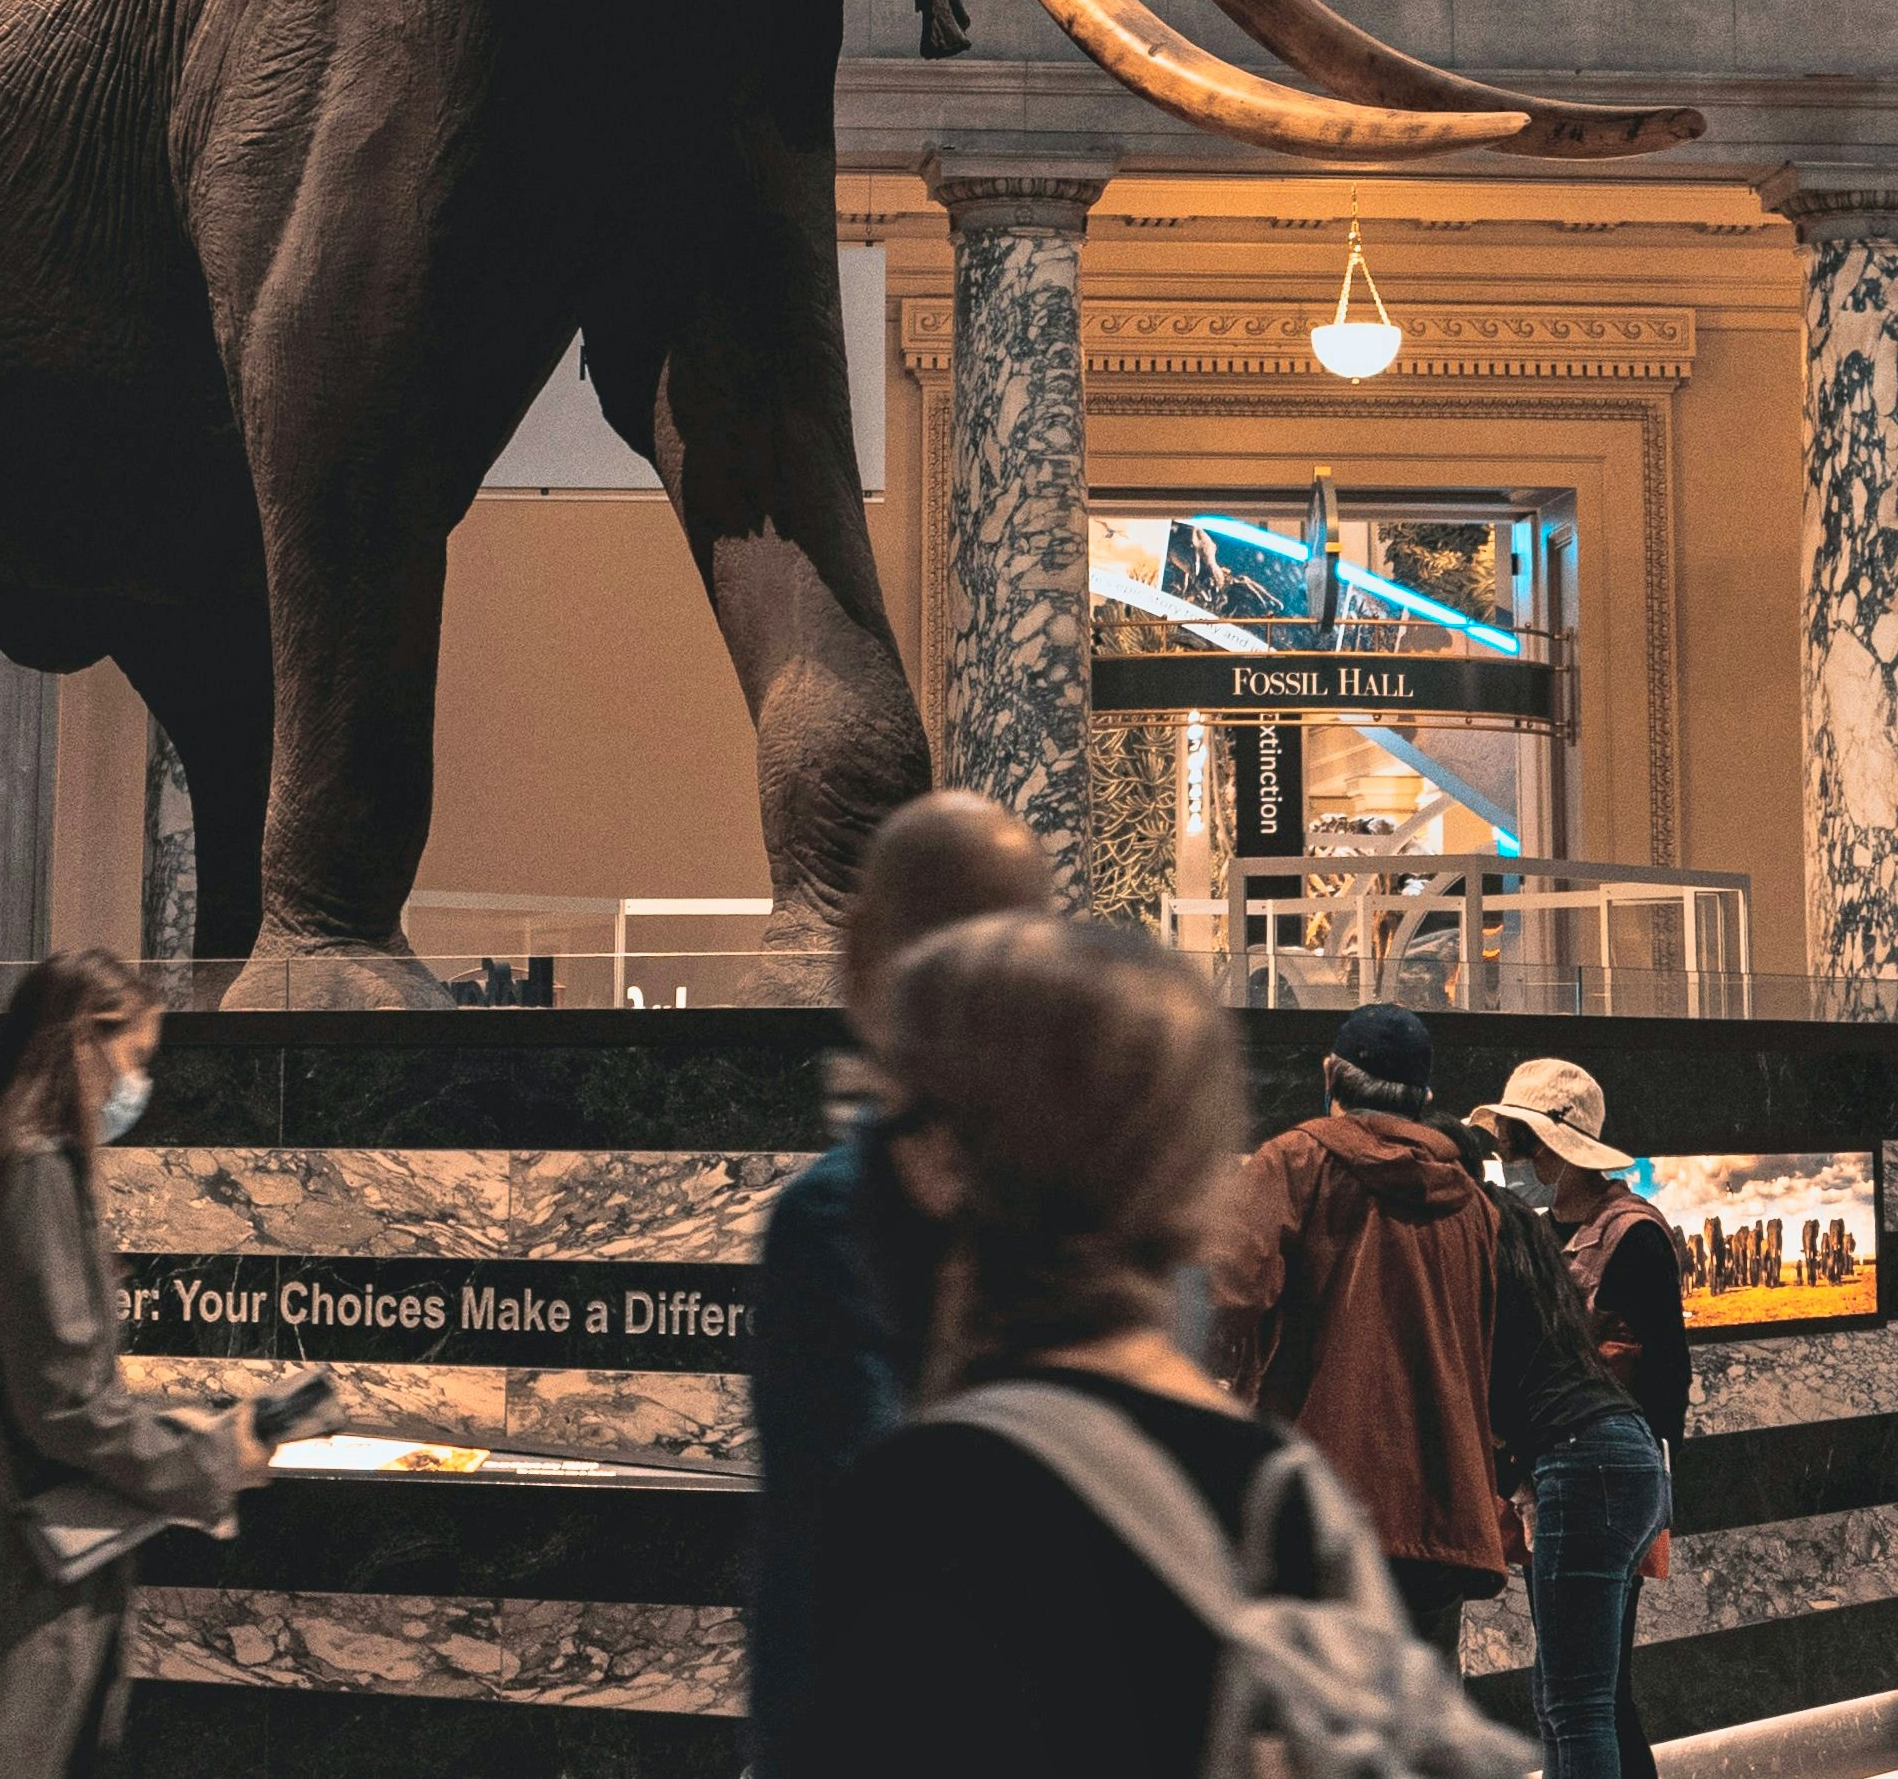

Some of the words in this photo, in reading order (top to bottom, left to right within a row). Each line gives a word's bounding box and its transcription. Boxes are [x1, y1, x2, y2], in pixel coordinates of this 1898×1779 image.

[1232, 667, 1328, 696] FOSSIL
[1337, 668, 1414, 698] HALL
[174, 1279, 267, 1323] Your
[280, 1281, 445, 1328] Choices
[461, 1285, 570, 1333] Make
[585, 1299, 608, 1334] a
